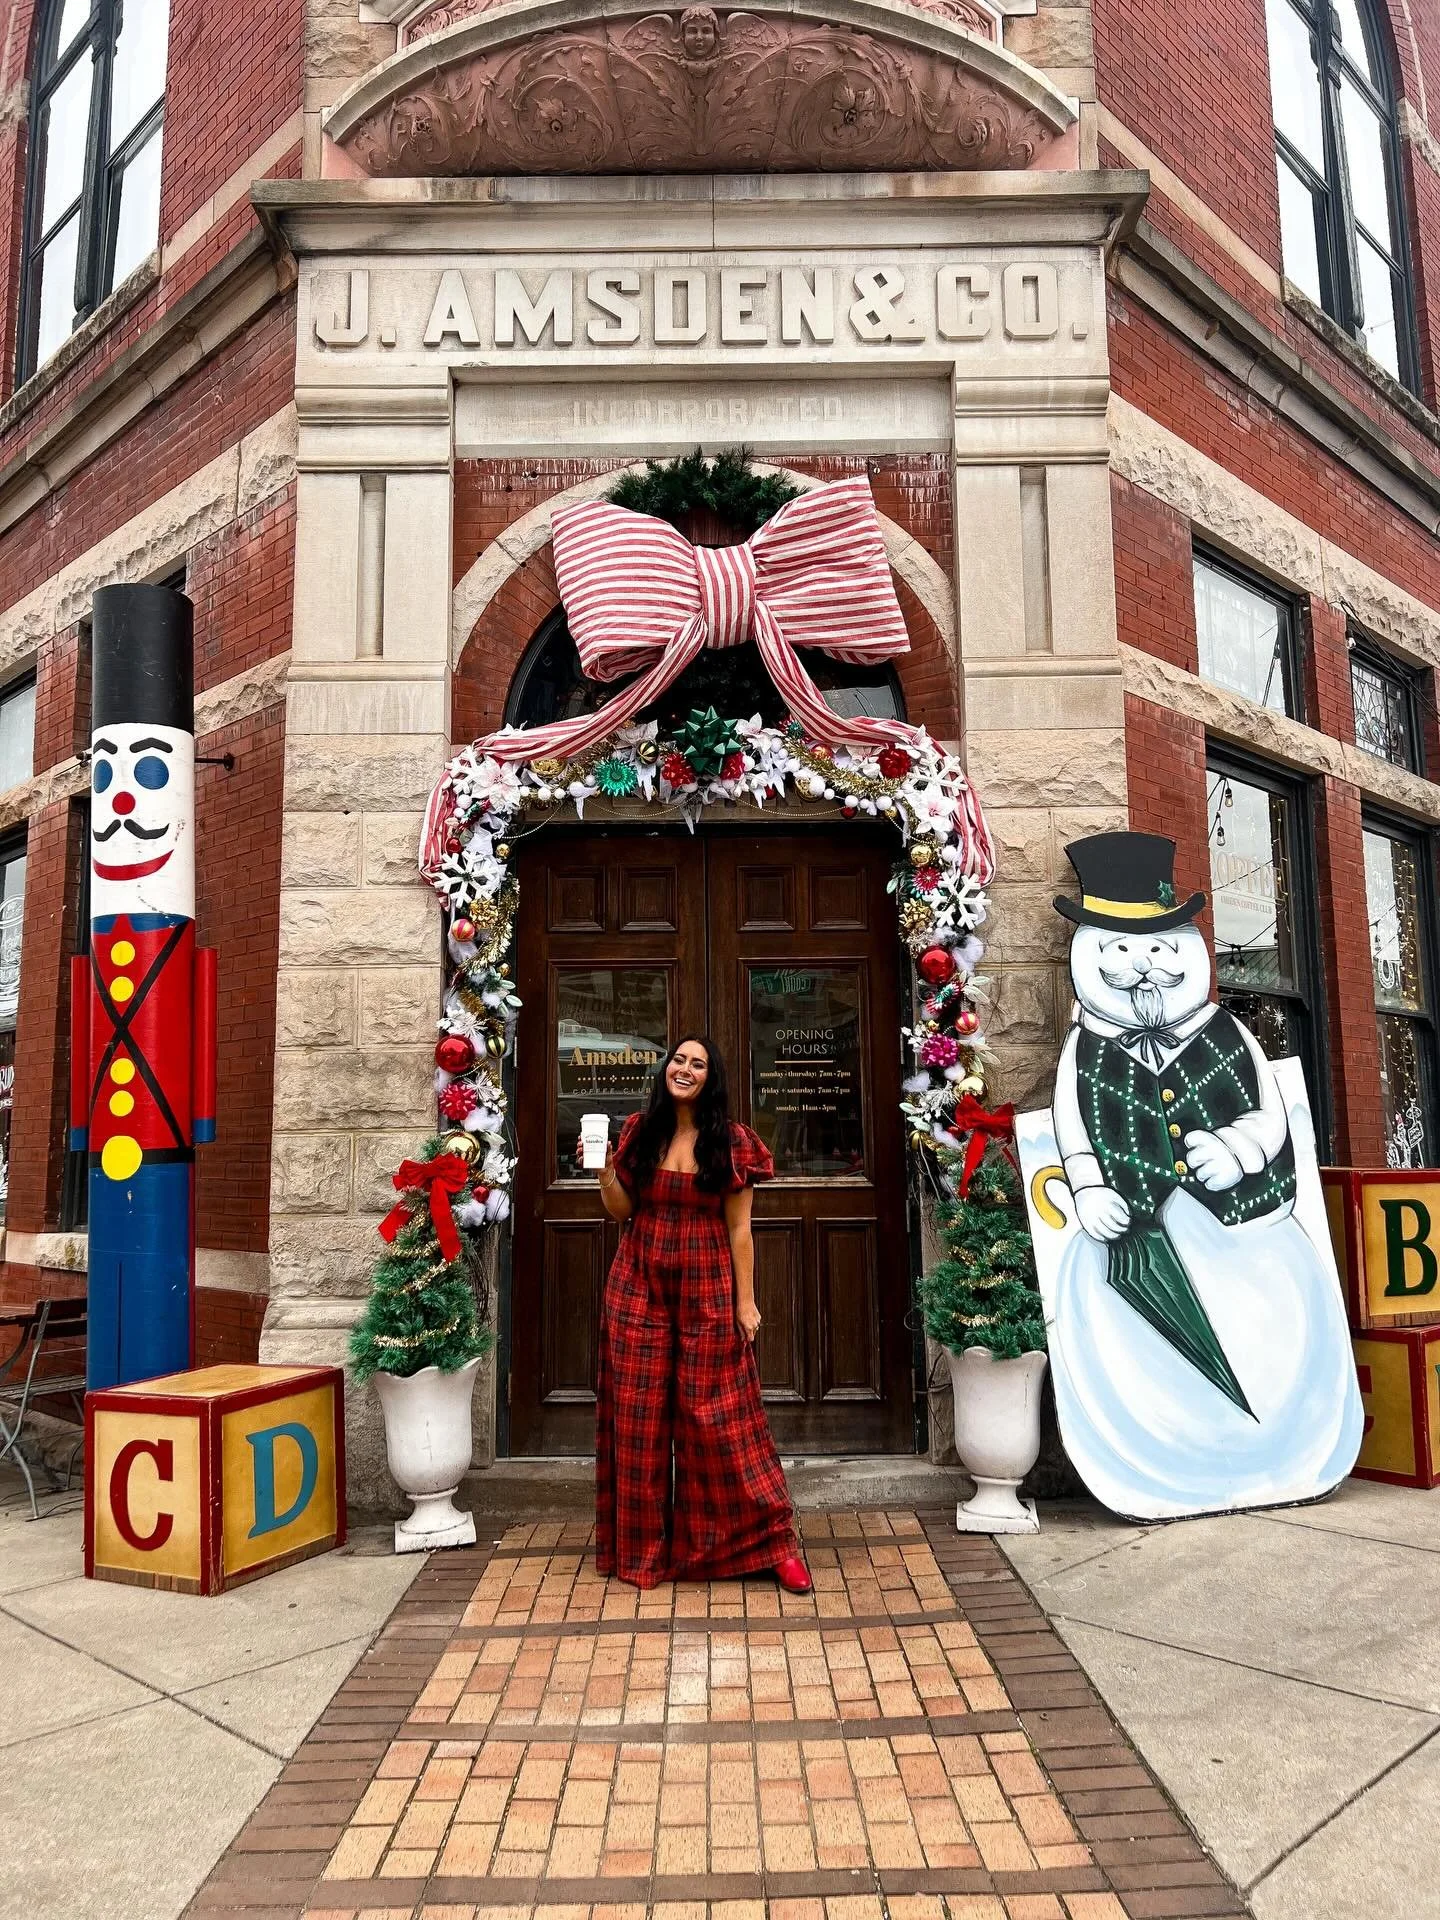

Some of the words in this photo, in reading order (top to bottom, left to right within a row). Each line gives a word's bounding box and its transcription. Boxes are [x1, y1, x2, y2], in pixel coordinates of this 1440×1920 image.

[315, 268, 397, 347] J.
[775, 1029, 834, 1040] OPENING
[568, 1045, 658, 1067] Amsden
[782, 1043, 828, 1055] HOURS
[572, 1087, 616, 1096] COFFEE
[761, 1086, 779, 1096] friday
[1379, 1198, 1438, 1298] B
[245, 1421, 319, 1540] D
[109, 1438, 174, 1552] C
